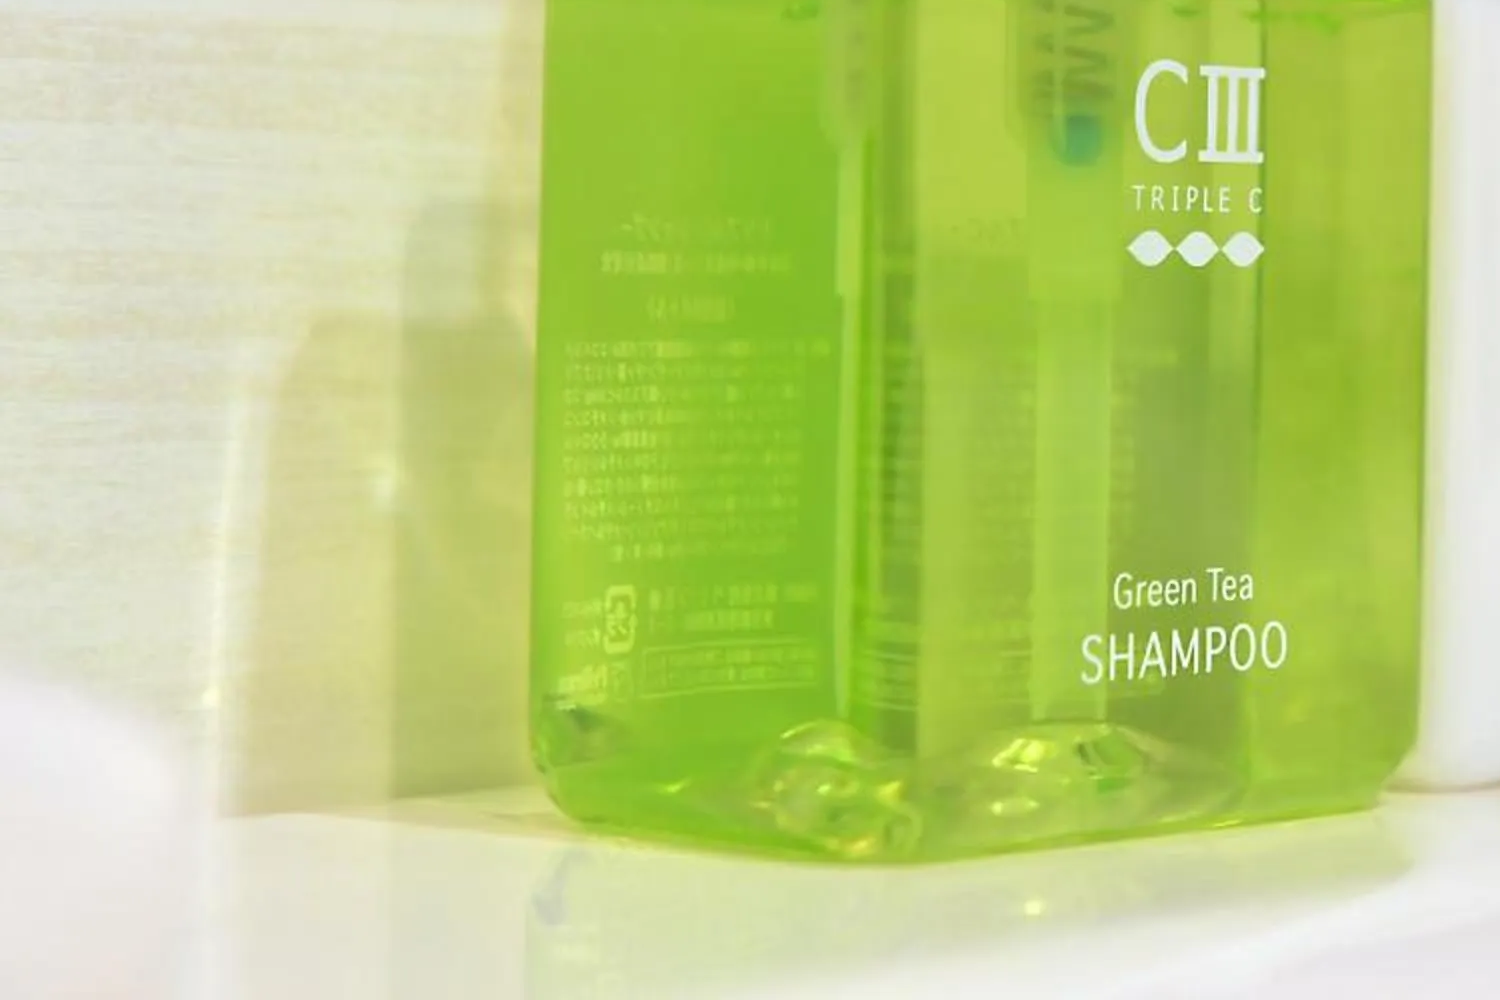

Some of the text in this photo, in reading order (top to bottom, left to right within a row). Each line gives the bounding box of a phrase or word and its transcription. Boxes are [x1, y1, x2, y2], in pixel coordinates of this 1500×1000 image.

[1131, 184, 1263, 213] TRIPLE C
[1113, 567, 1253, 610] Green Tea
[1081, 620, 1288, 685] SHAMPOO
